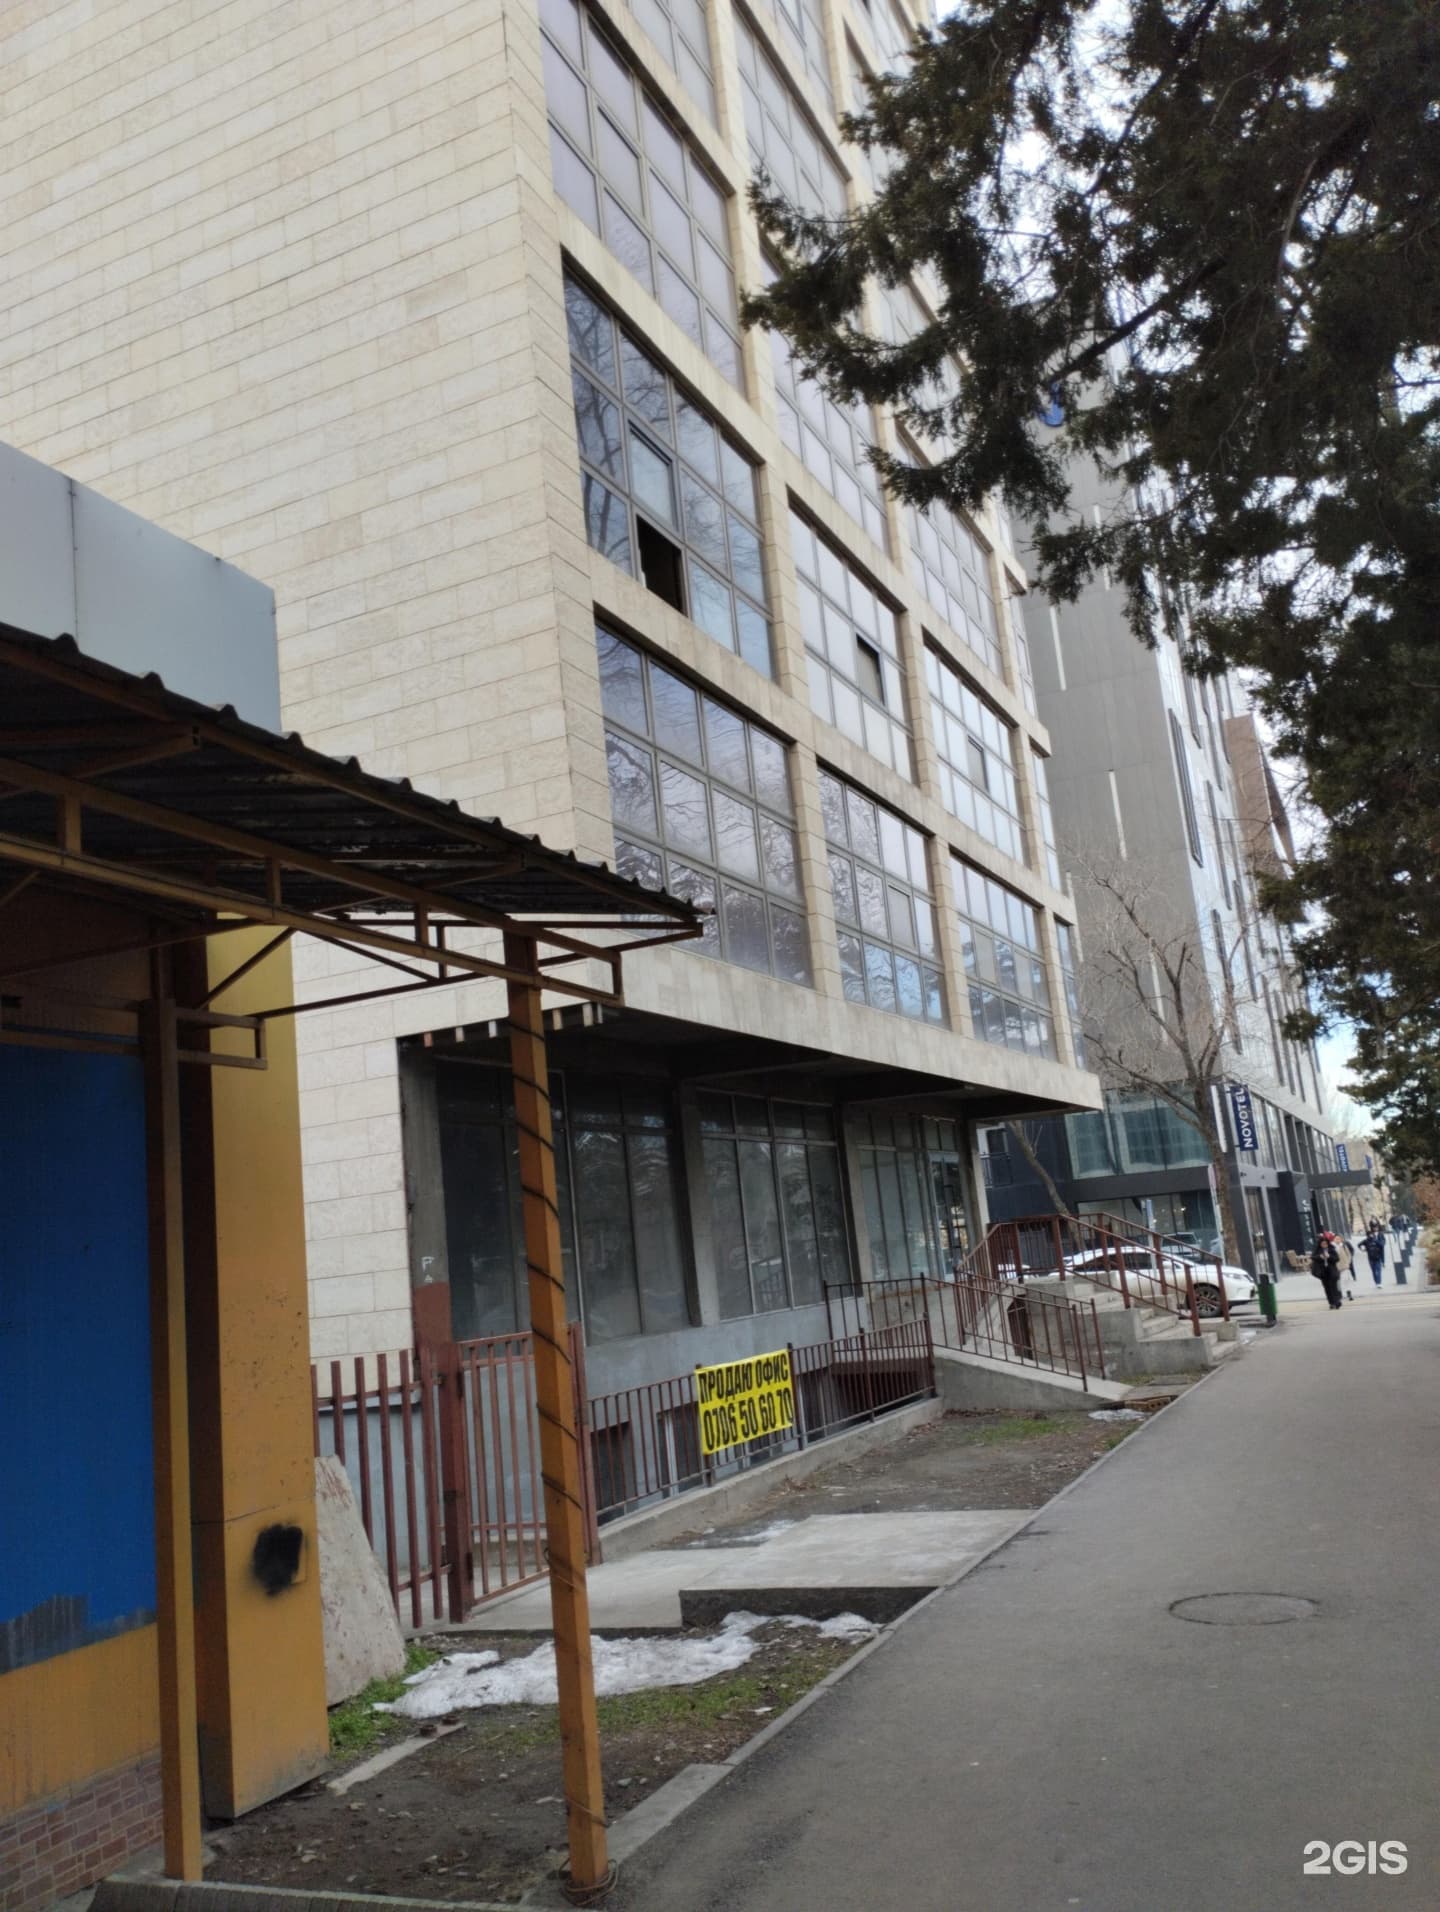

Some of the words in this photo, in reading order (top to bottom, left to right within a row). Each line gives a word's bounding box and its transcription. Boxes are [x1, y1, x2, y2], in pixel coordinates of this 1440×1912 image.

[1235, 1087, 1254, 1148] NOVOTEL
[698, 1362, 753, 1404] ПРОДАЮ
[755, 1353, 788, 1389] ОФИС
[703, 1402, 738, 1451] 0706
[738, 1397, 759, 1439] 50
[759, 1391, 777, 1432] 60
[776, 1387, 794, 1426] 70
